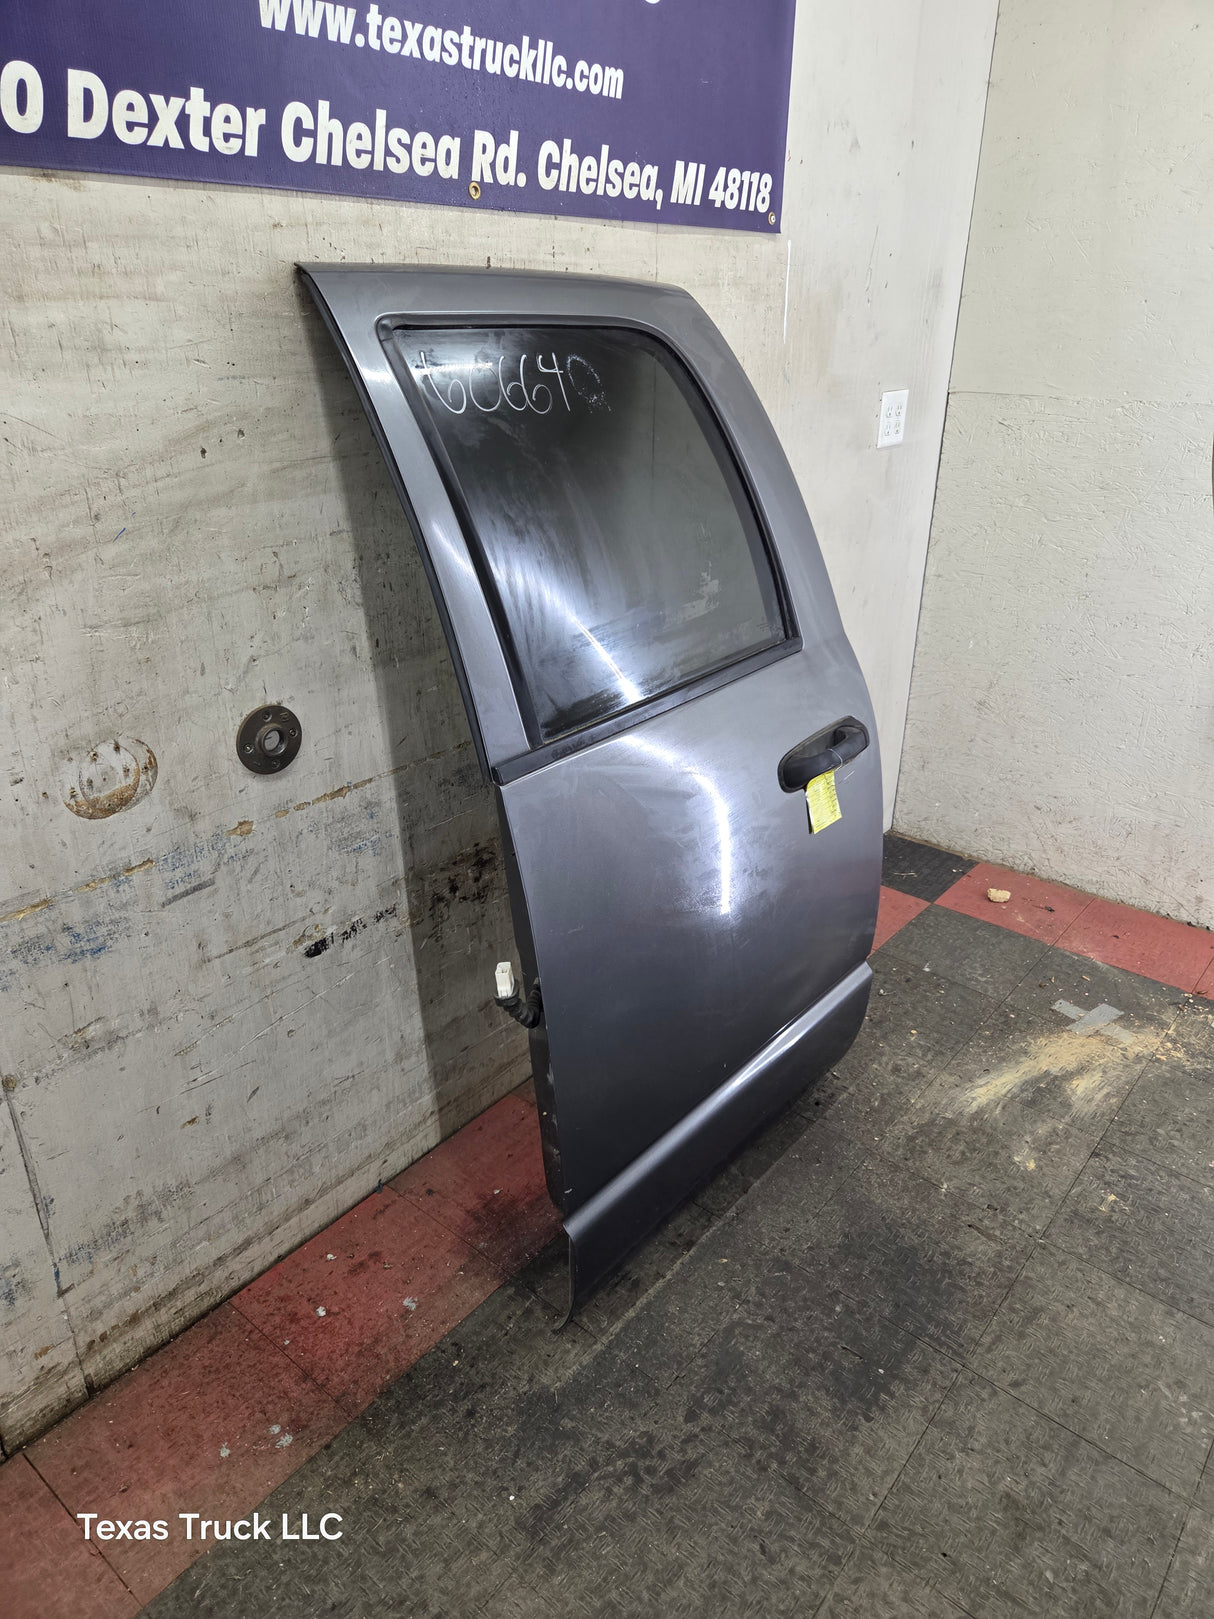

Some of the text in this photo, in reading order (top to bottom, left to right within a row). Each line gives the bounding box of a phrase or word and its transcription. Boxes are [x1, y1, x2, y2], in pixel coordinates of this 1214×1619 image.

[259, 0, 624, 99] www.texastruckllc.com
[67, 68, 266, 157] Dexter
[281, 99, 461, 180] Chelsea
[471, 129, 527, 188] Rd.
[537, 138, 664, 211] Chelsea,
[670, 160, 706, 206] MI
[708, 166, 773, 213] 48118
